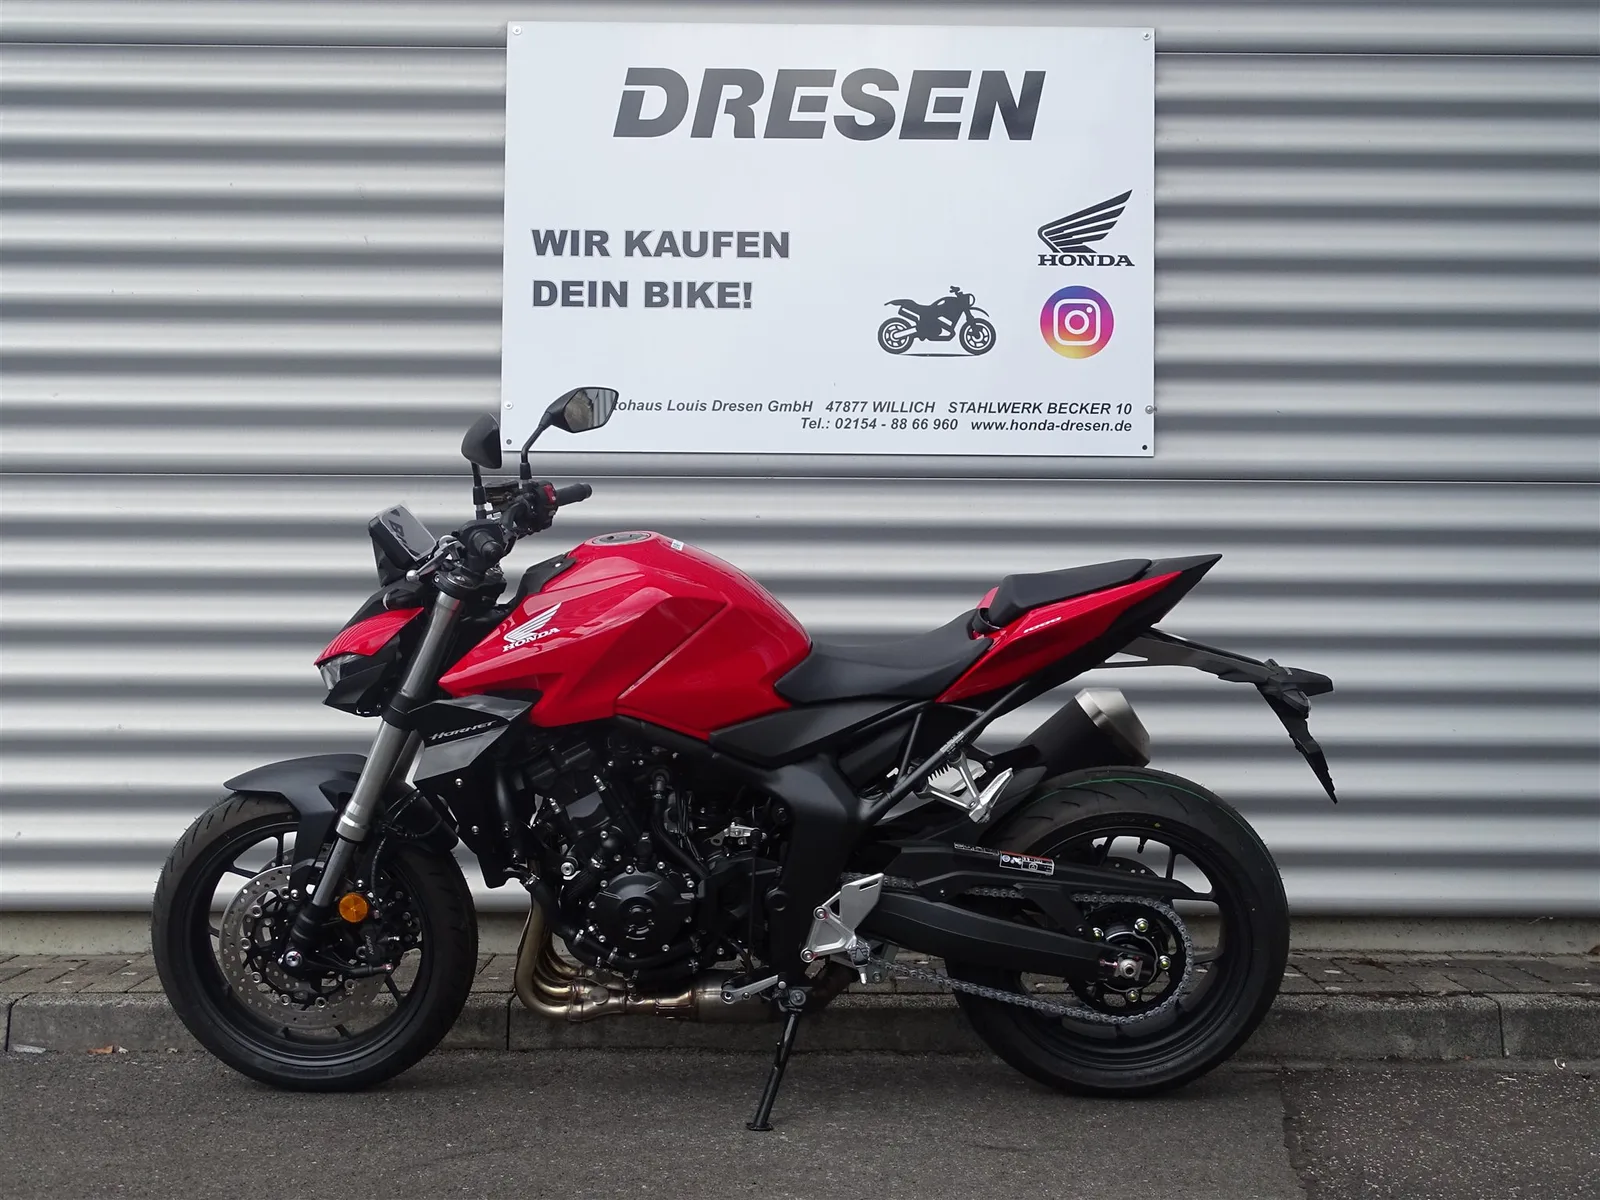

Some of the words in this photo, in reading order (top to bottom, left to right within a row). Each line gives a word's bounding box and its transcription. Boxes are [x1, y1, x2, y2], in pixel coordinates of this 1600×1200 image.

[613, 68, 1046, 141] DRESEN
[532, 229, 610, 257] WIR
[625, 231, 789, 258] KAUFEN
[1038, 254, 1135, 267] HONDA
[532, 281, 628, 308] DEIN
[644, 281, 752, 309] BIKE!
[667, 399, 707, 411] Louis
[712, 400, 763, 412] Dresen
[767, 400, 813, 412] GmbH
[825, 401, 868, 412] 47877
[873, 401, 936, 413] WILLICH
[948, 402, 1043, 414] STAHLWERK
[1047, 403, 1111, 414] BECKER
[1116, 403, 1132, 414] 10
[801, 418, 830, 430] Tel.:
[835, 418, 877, 429] 02154
[891, 418, 907, 429] 88
[912, 419, 928, 430] 66
[933, 419, 958, 430] 960
[971, 419, 1132, 431] www.honda-dresen.de
[502, 627, 561, 652] HONDA
